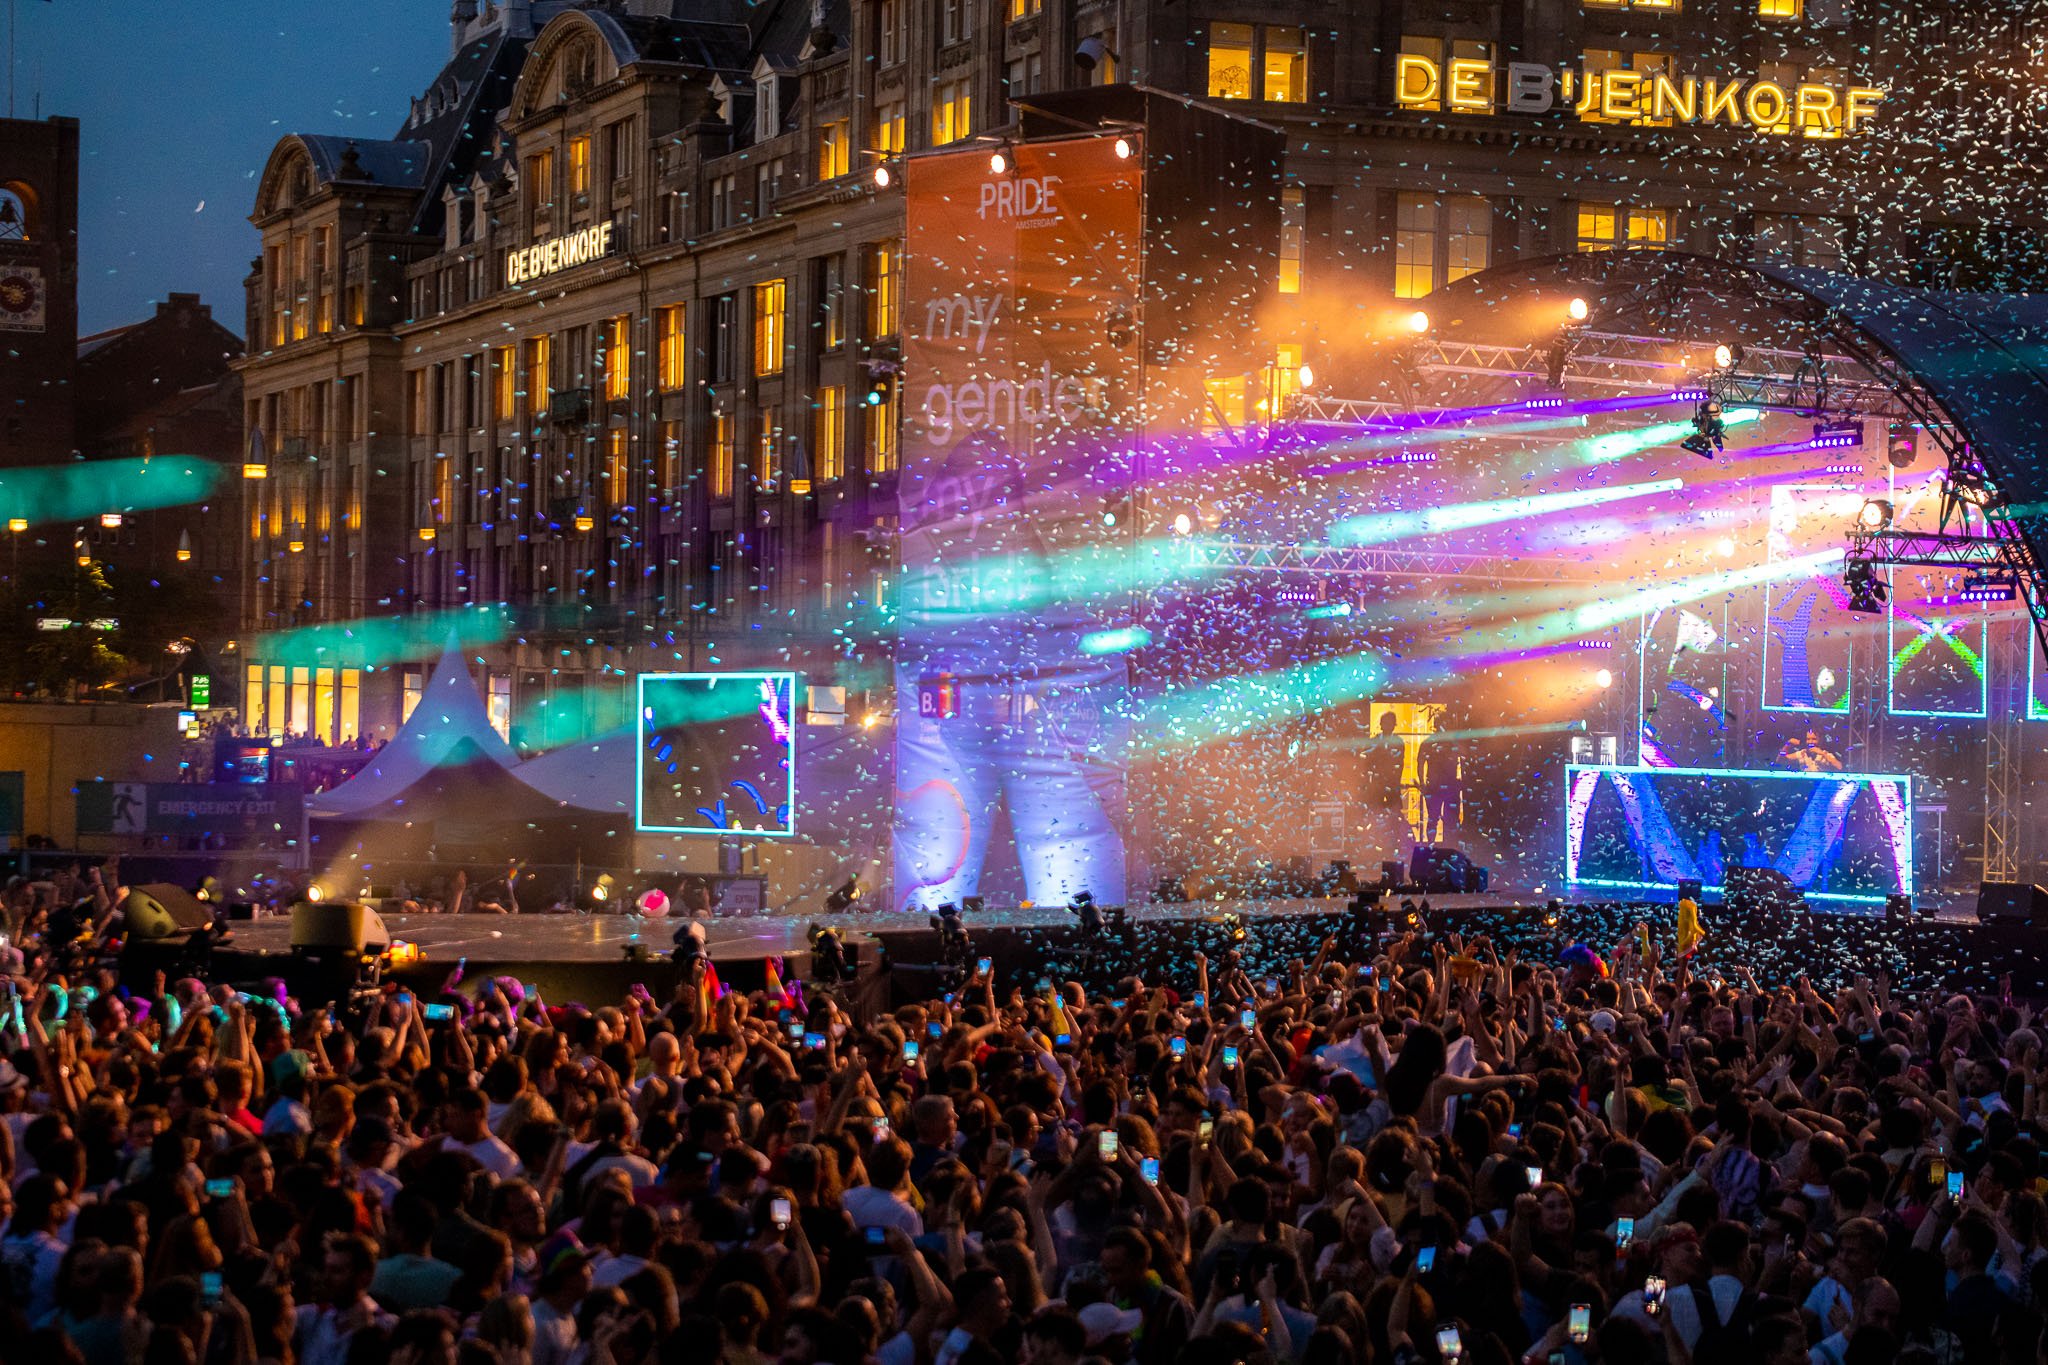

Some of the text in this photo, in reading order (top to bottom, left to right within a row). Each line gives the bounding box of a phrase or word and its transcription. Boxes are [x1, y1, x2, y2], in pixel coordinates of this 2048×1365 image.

[1396, 54, 1884, 135] DE BIJENKORF
[981, 175, 1058, 220] PRIDE
[1015, 218, 1057, 230] AMSTERDAM
[926, 293, 1004, 353] my
[159, 801, 276, 815] EMERGENCY EXIT
